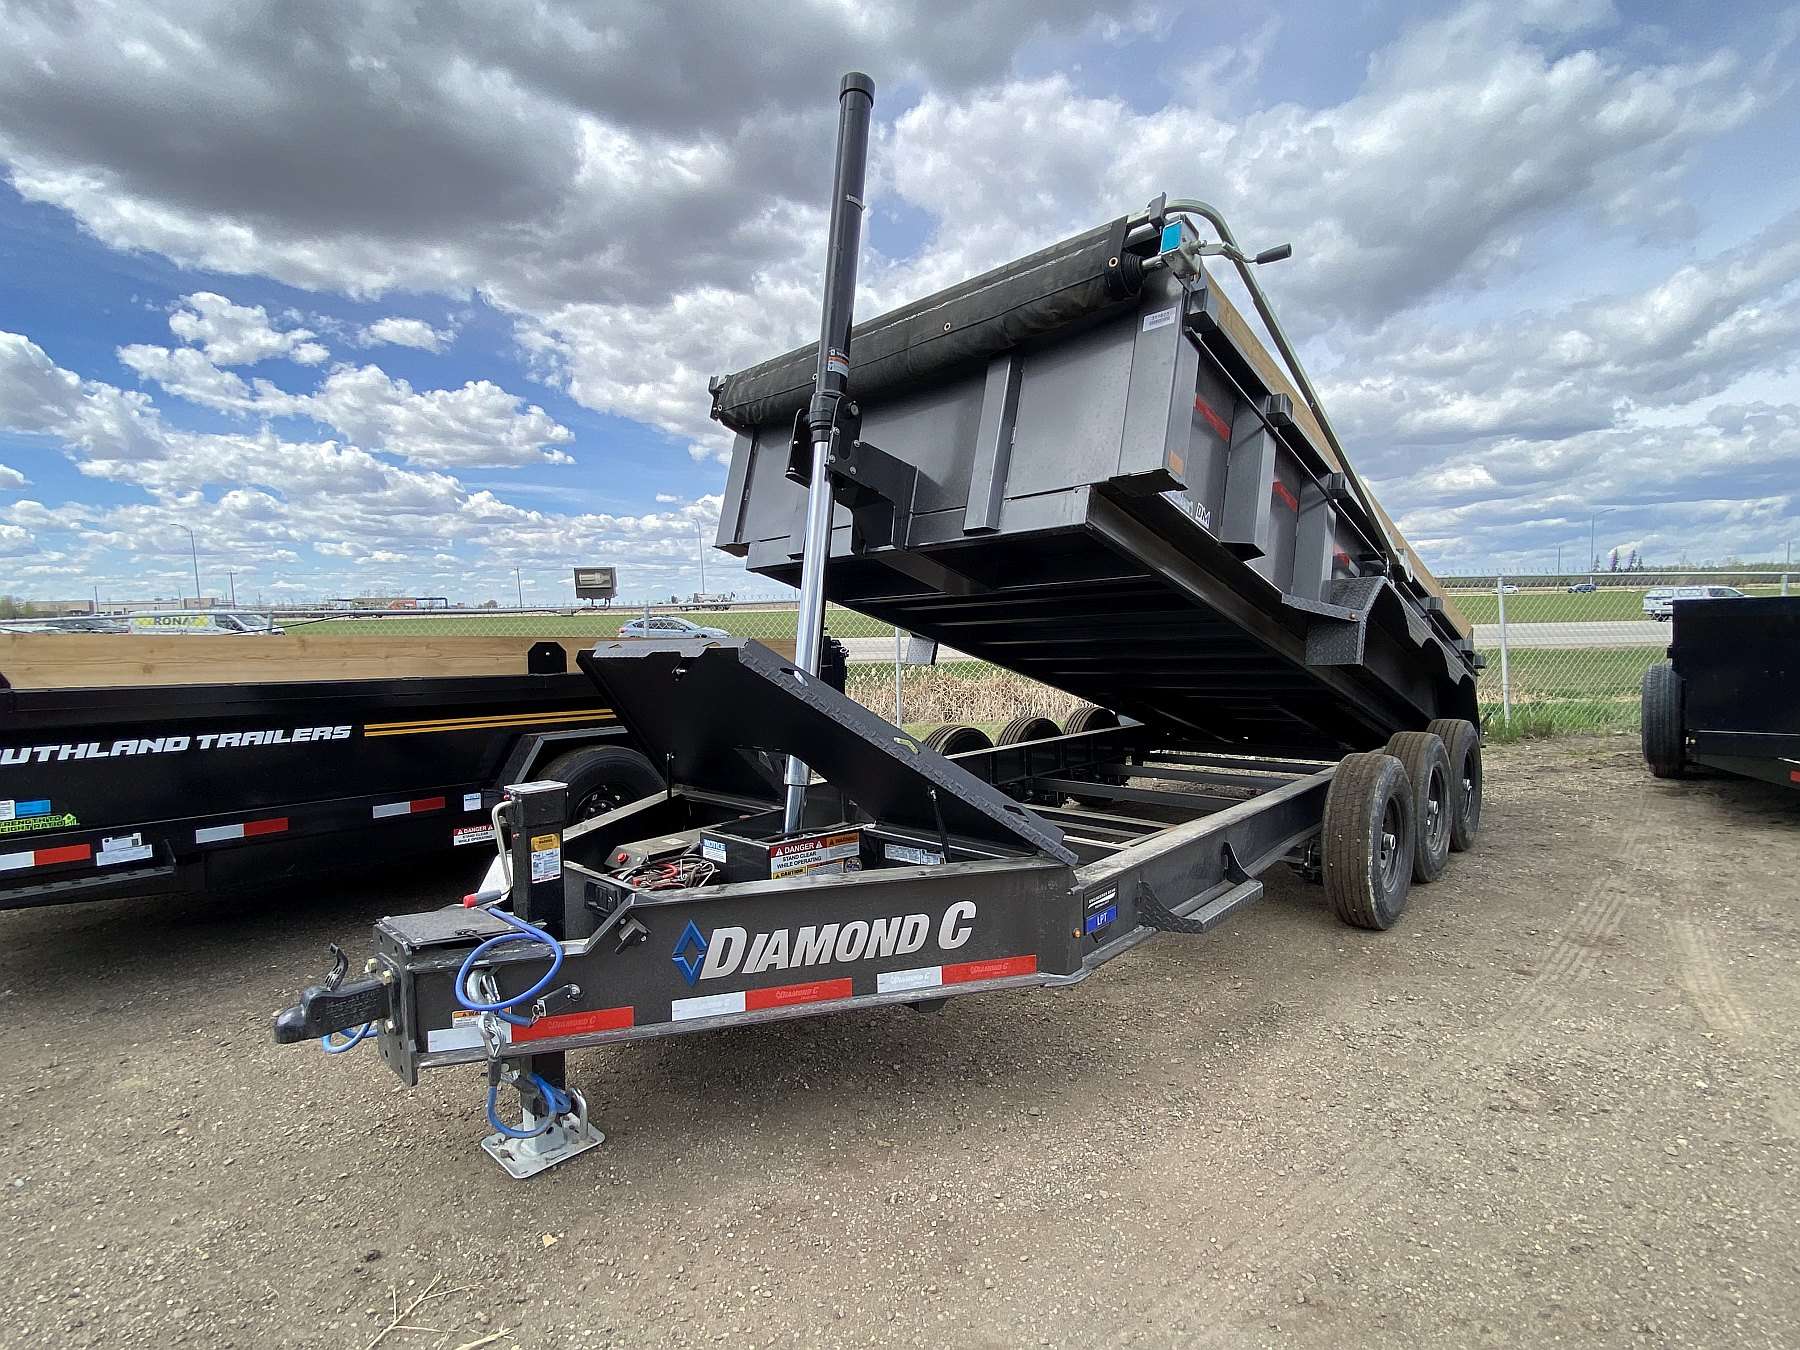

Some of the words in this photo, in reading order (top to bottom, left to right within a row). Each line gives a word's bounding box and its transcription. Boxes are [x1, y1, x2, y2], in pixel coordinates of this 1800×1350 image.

[0, 735, 190, 765] UTHLAND
[196, 725, 352, 749] TRAILERS
[464, 825, 487, 834] DANGER
[703, 839, 726, 850] NOTICE
[784, 842, 815, 854] DANGER
[776, 861, 793, 869] WHILE
[793, 856, 822, 866] OPERATING
[782, 854, 800, 862] STAND
[800, 851, 817, 859] CLEAR
[781, 868, 804, 877] CAUTION
[1097, 912, 1107, 926] LPT
[700, 913, 930, 980] DIAMOND
[937, 900, 977, 950] C
